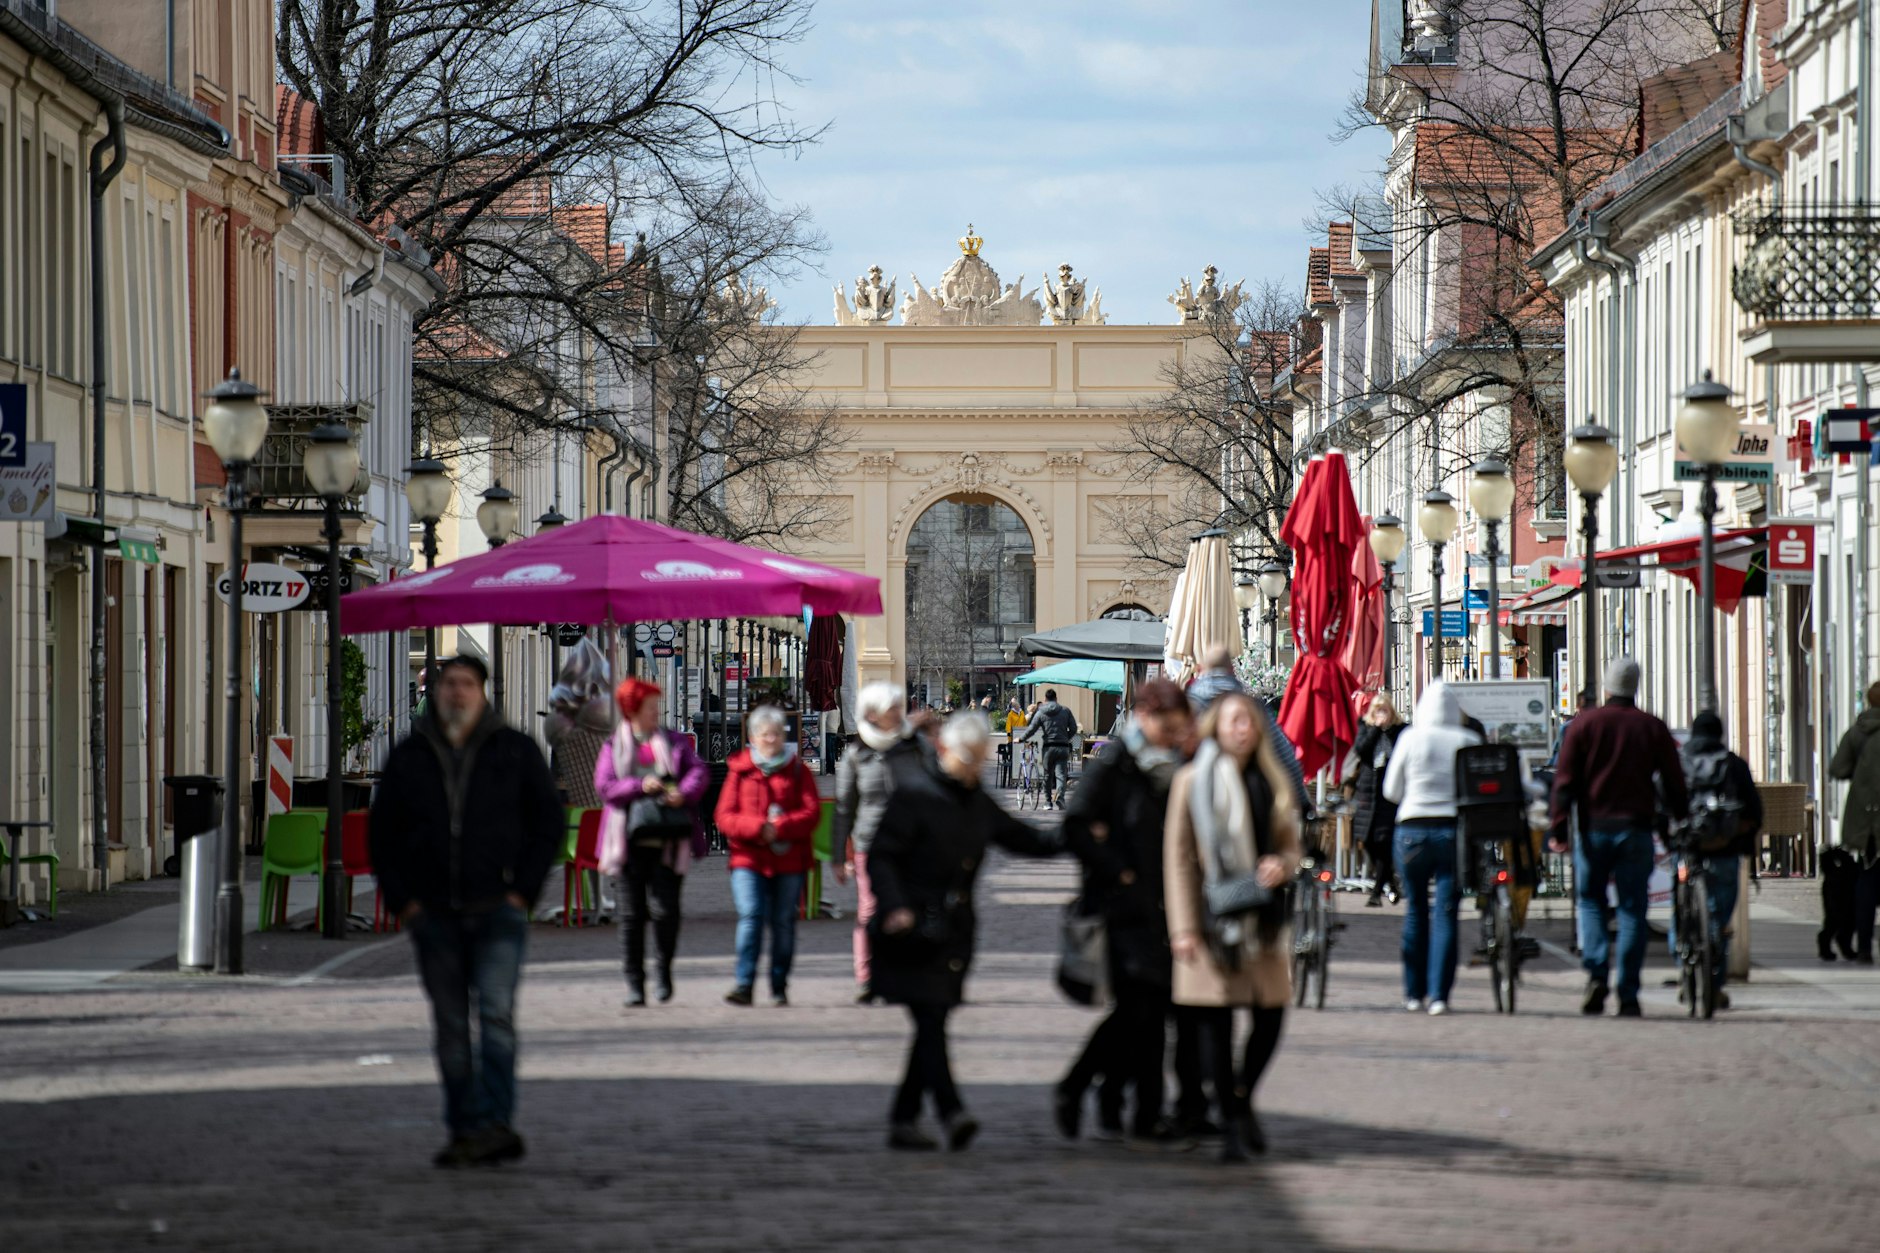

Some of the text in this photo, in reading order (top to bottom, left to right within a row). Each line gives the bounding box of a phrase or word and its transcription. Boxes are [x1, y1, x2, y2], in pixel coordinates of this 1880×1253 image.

[0, 462, 53, 488] malfi
[1680, 465, 1769, 479] Imobilien
[309, 575, 349, 588] eco
[286, 581, 305, 598] 17
